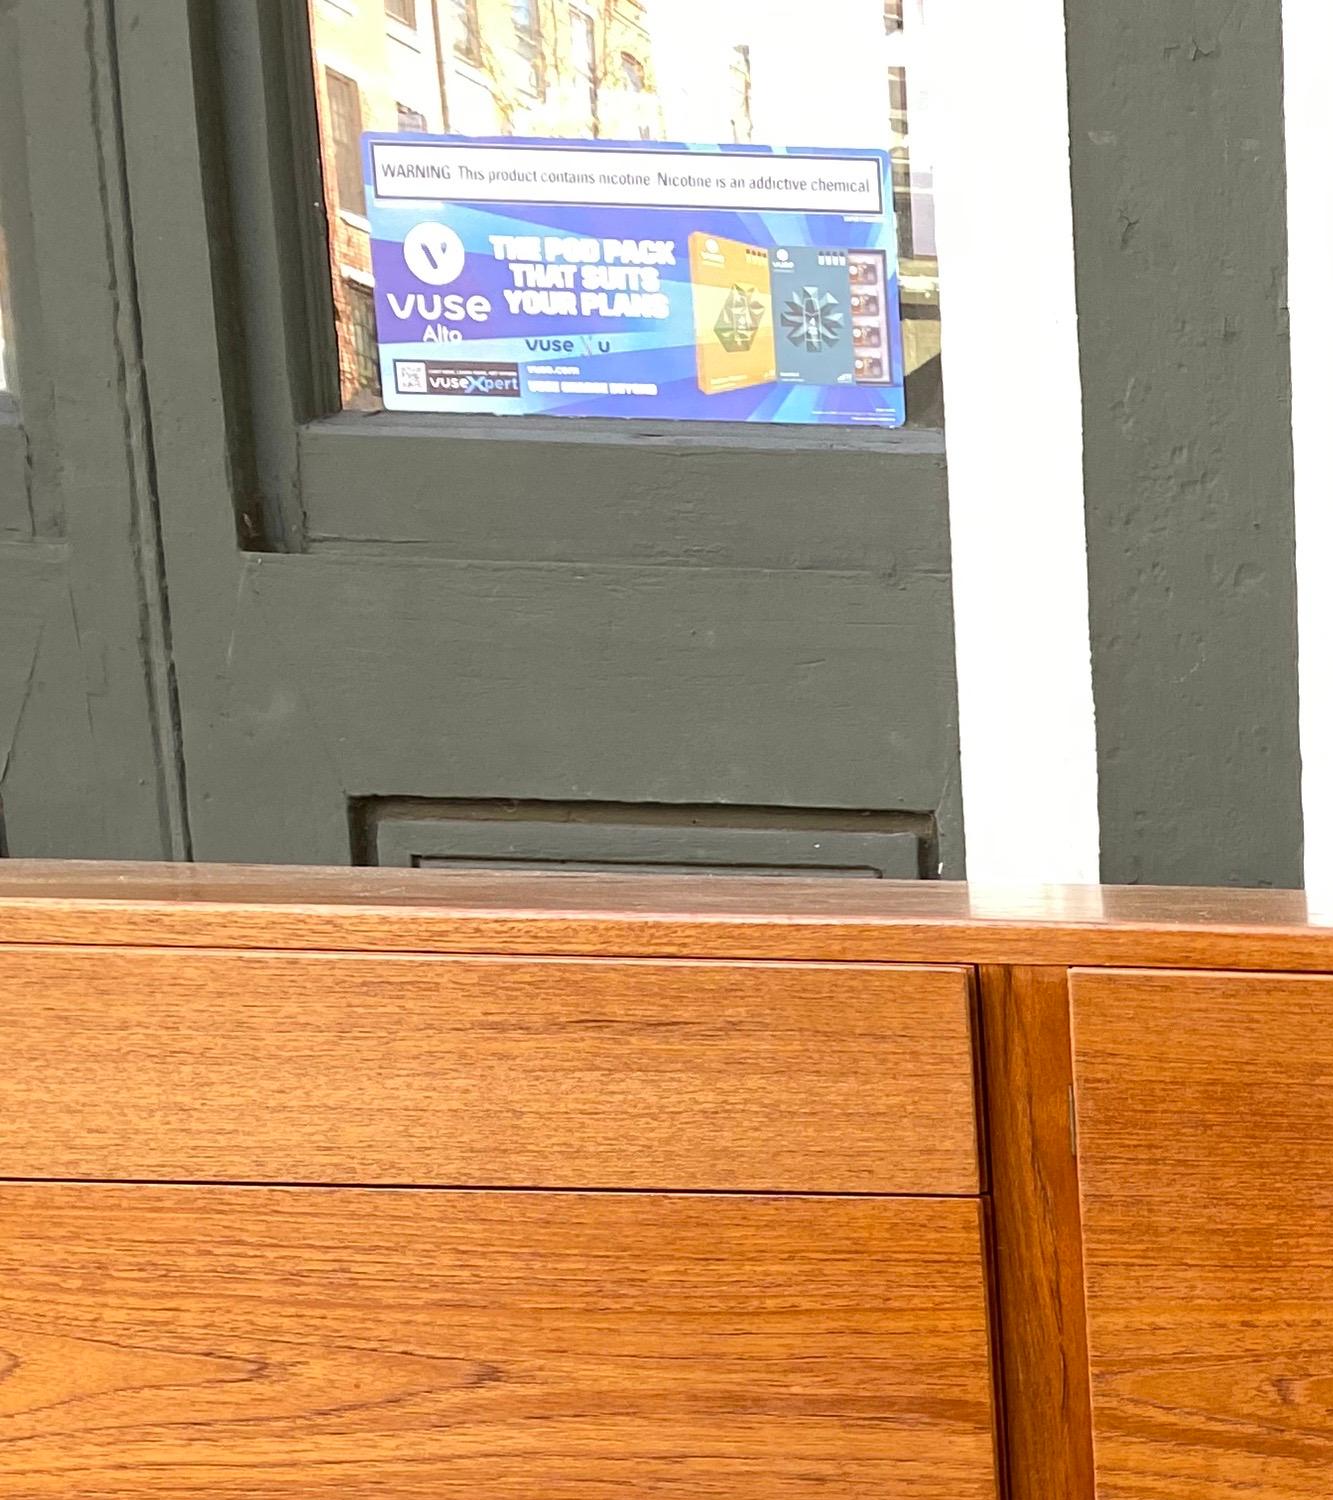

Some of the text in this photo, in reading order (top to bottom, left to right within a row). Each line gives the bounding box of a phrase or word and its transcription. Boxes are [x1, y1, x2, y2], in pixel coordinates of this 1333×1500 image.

[458, 165, 485, 180] This
[488, 167, 537, 184] product
[541, 170, 595, 185] contains
[657, 172, 711, 188] Nicotine
[716, 176, 726, 189] is
[730, 178, 745, 189] an
[749, 175, 807, 191] addictive
[488, 234, 543, 262] THE
[543, 235, 600, 264] POD
[602, 238, 676, 266] PACK
[508, 262, 661, 293] THAT SUITS
[503, 289, 670, 320] YOUR PLANS
[422, 322, 463, 343] Alto
